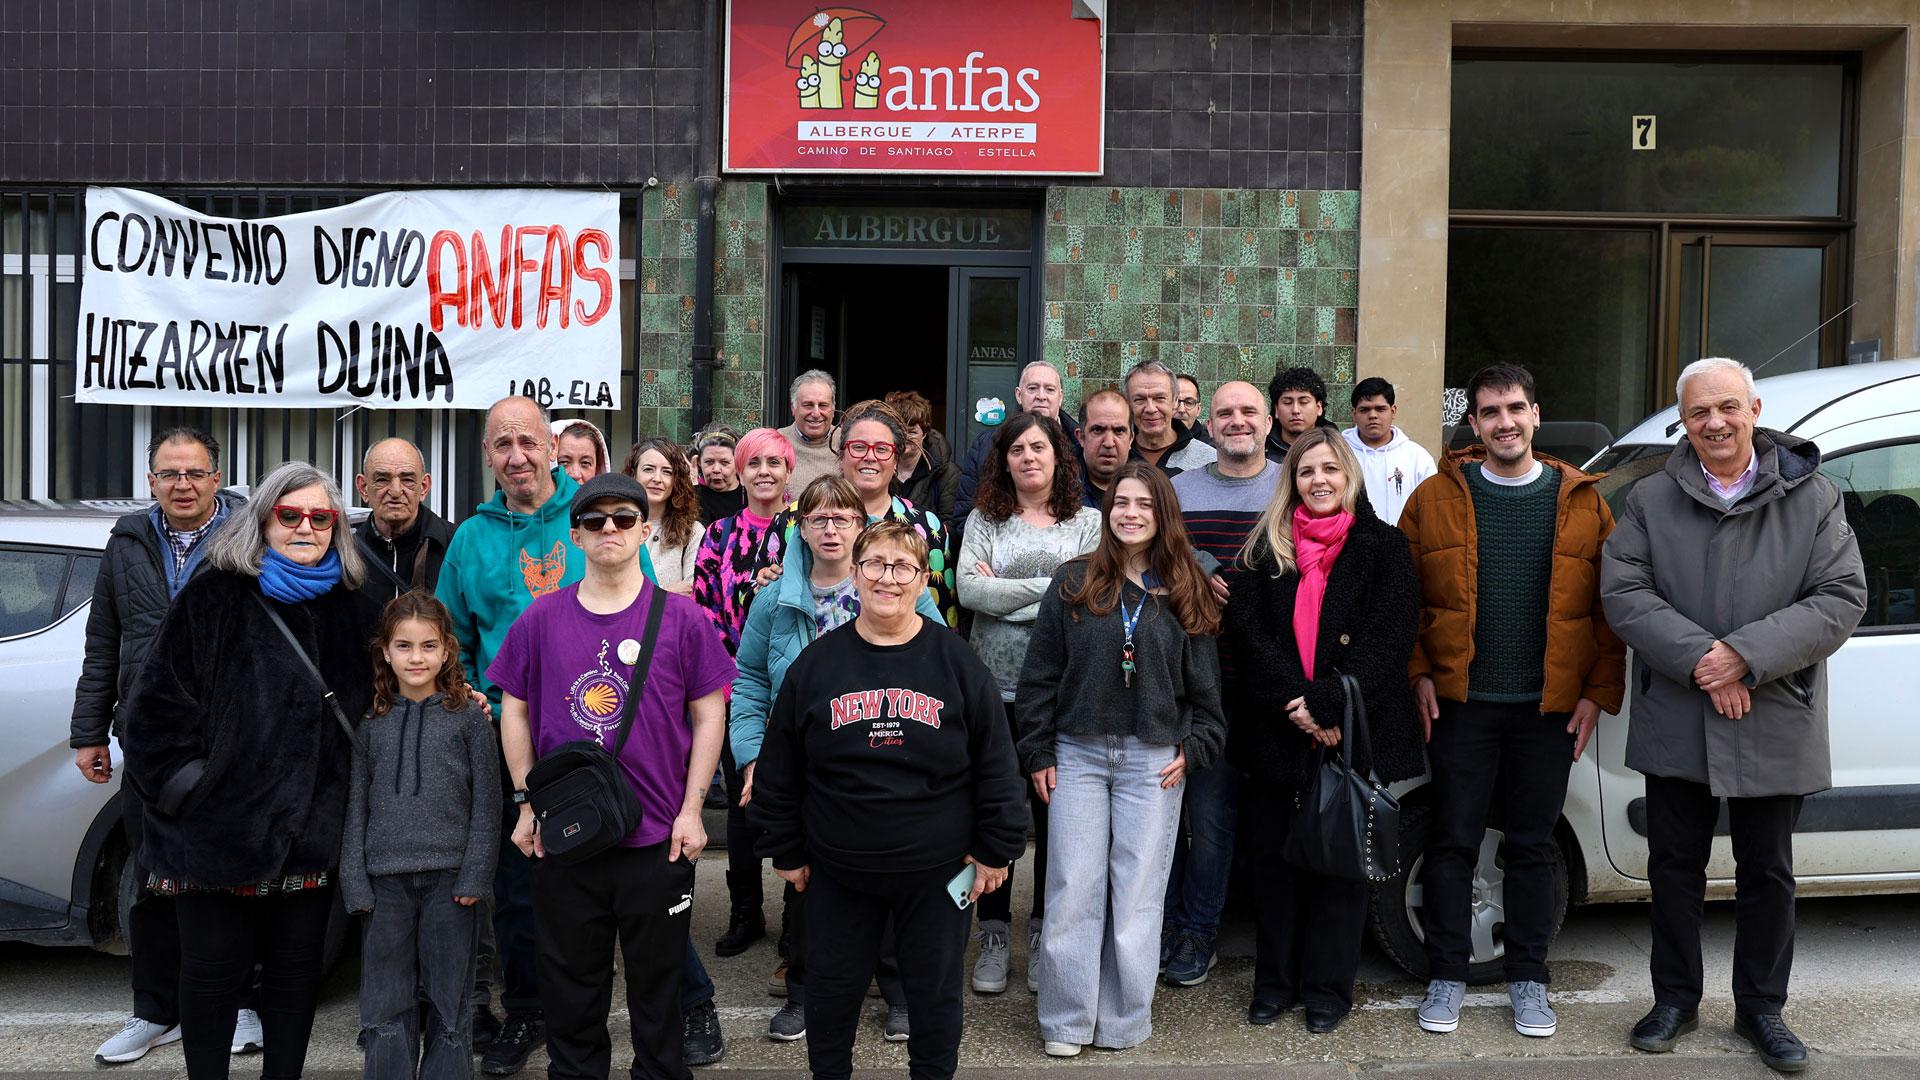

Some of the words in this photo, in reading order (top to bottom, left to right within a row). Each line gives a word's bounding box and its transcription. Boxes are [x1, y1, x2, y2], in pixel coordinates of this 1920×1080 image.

[885, 51, 1040, 112] anfas
[810, 126, 912, 138] ALBERGUE
[951, 127, 1024, 139] ATERPE
[1636, 118, 1652, 147] 7
[797, 146, 849, 155] CAMINO
[860, 147, 876, 156] DE
[887, 147, 953, 157] SANTIAGO
[978, 148, 1036, 158] ESTELLA
[814, 214, 1001, 245] ALBERGUE
[91, 211, 287, 285] CONVENIO
[314, 225, 425, 288] DIGNO
[427, 224, 613, 333] ANFAS
[84, 313, 289, 394] HITZARMEN
[317, 320, 454, 402] DUINA
[970, 346, 1016, 359] ANFAS
[830, 688, 885, 730] NEW
[886, 687, 944, 730] YORK
[868, 730, 904, 738] AMERICA
[870, 735, 904, 748] Cities
[668, 898, 690, 916] PUMA
